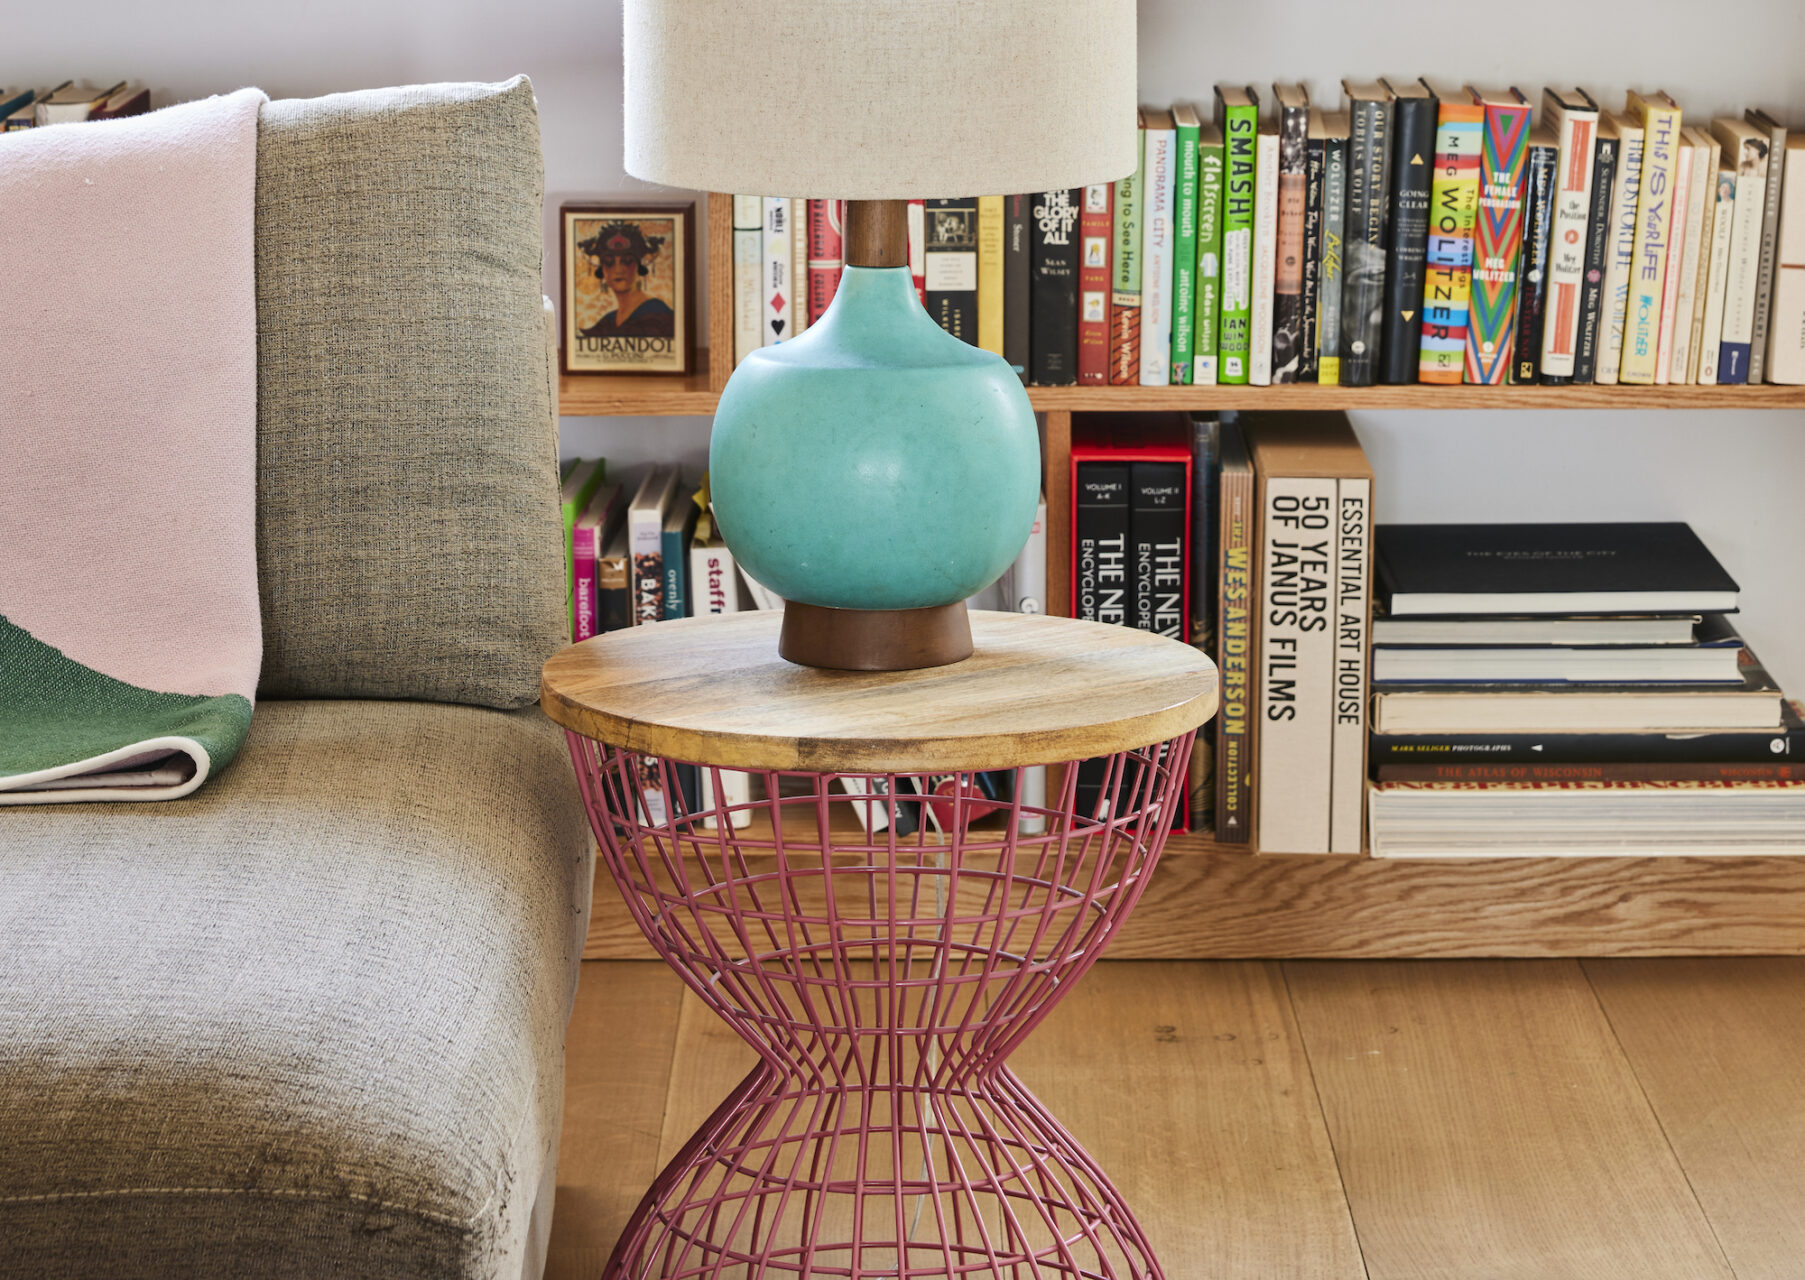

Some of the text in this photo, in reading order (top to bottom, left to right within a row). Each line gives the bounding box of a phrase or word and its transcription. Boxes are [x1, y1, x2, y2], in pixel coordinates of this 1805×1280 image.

[1043, 194, 1070, 207] THE
[1152, 140, 1167, 249] PANORAMA CITY
[1181, 141, 1196, 237] mouth to mouth
[1201, 154, 1222, 243] flatscreen
[1228, 118, 1254, 224] SMASH!
[1329, 149, 1341, 221] WOLITZER
[1367, 110, 1384, 250] OUR STORY BEGINS
[1399, 190, 1430, 198] GOING
[1399, 200, 1429, 209] CLEAR
[1013, 223, 1022, 252] Stoner
[1033, 206, 1079, 220] GLORY
[1039, 219, 1074, 232] OF IT
[1043, 232, 1070, 245] ALL
[1121, 203, 1134, 283] to See Here
[1431, 136, 1459, 340] MEG WOLITZER
[1458, 189, 1475, 289] The Interestings
[576, 336, 675, 353] TURANDOT
[1120, 310, 1131, 378] Kevin Wilson
[1177, 269, 1191, 352] antoine wilson
[1201, 284, 1214, 352] adam wilson
[1223, 318, 1247, 329] IAN
[1582, 288, 1598, 357] MEG WOLITZER
[666, 569, 681, 610] ovenly
[1098, 533, 1125, 583] THE
[1155, 537, 1180, 587] THE
[1298, 496, 1329, 632] 50 YEARS
[579, 577, 593, 637] barefoot
[1224, 547, 1247, 735] WES ANDERSON
[1267, 495, 1300, 722] OF JANUS FILMS
[1337, 497, 1364, 725] ESSENTIAL ART HOUSE
[1226, 742, 1237, 811] COLLECTION
[1436, 767, 1602, 778] THE ATLAS OF WISCONSIN
